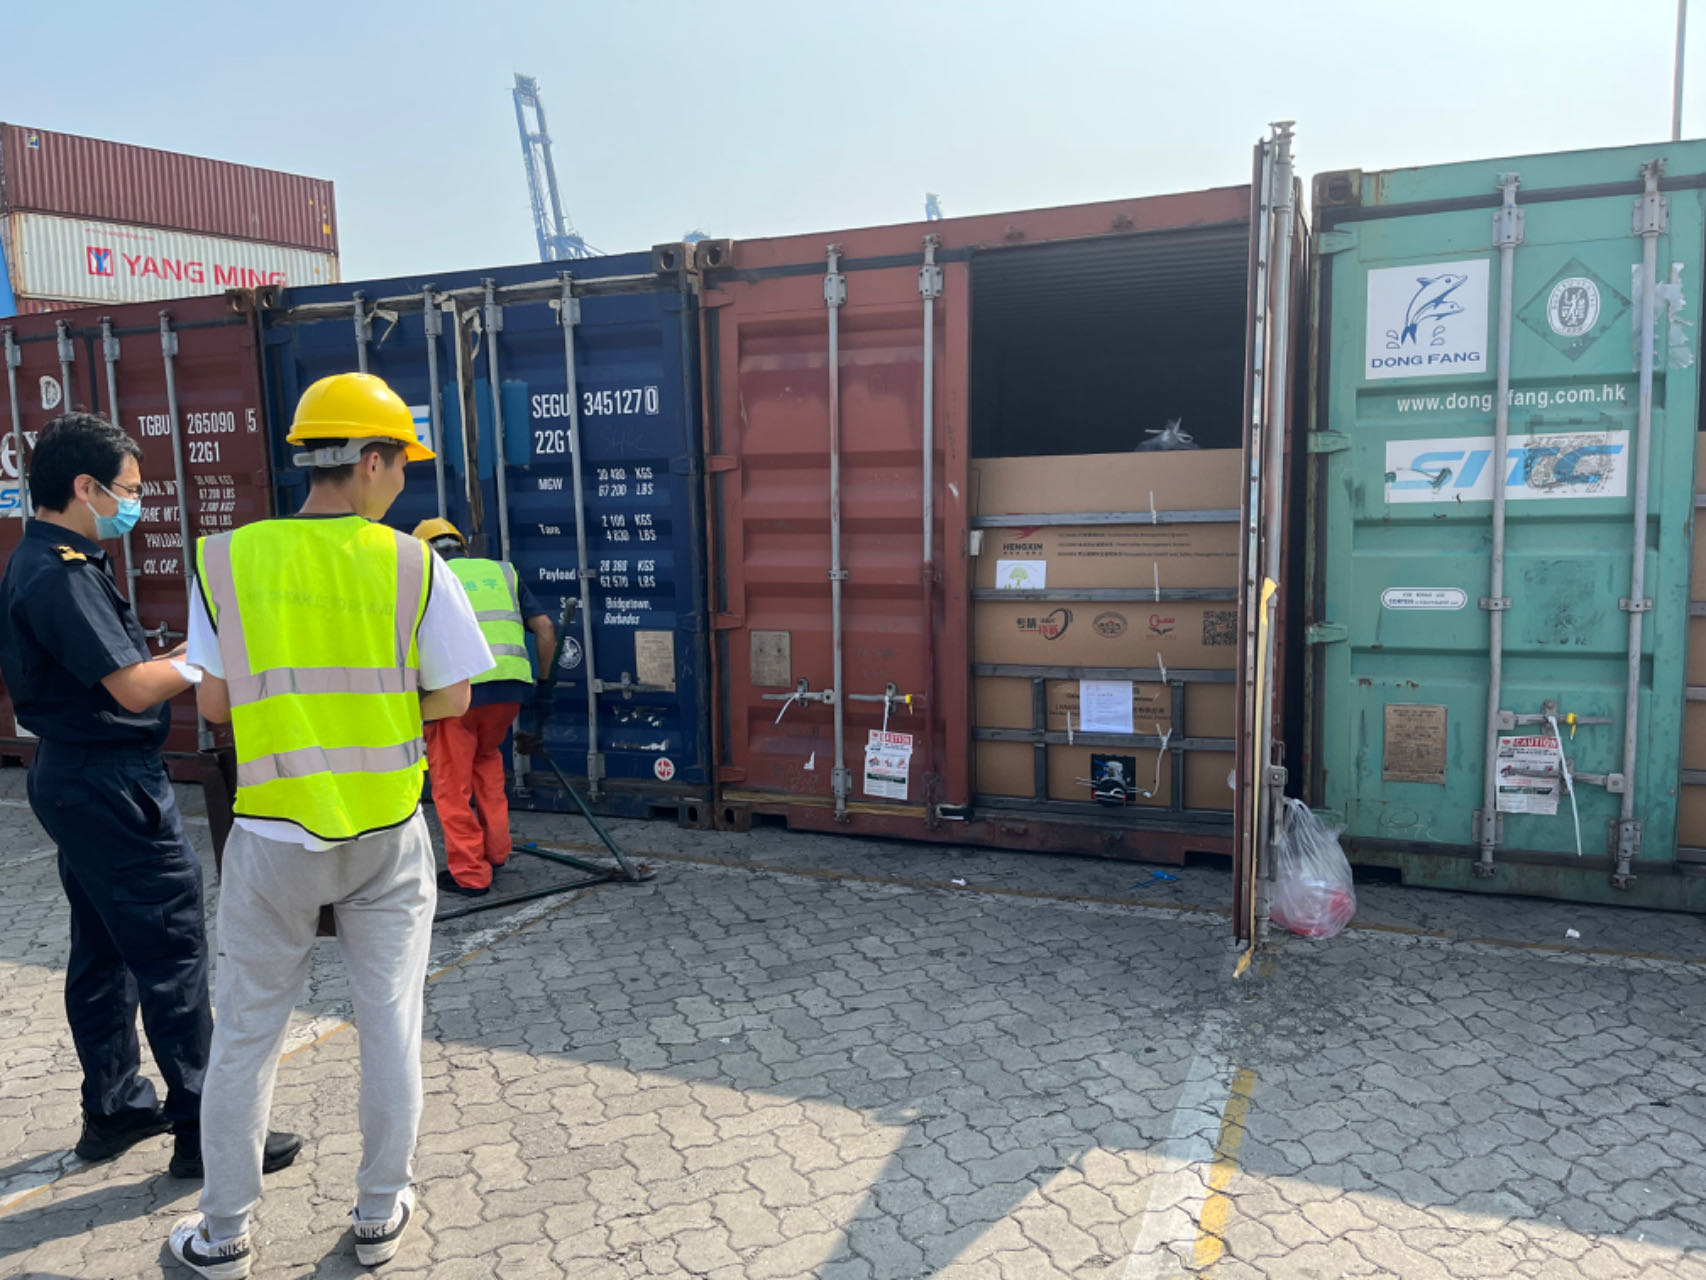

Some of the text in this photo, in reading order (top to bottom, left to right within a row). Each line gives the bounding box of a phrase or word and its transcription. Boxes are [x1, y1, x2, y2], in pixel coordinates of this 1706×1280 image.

[122, 252, 287, 288] YANG MING
[1371, 351, 1480, 368] DONG FANG
[532, 393, 571, 418] SEGU
[138, 414, 171, 437] TGBU
[187, 411, 236, 434] 265090
[534, 429, 573, 454] 22G1
[188, 441, 220, 463] 22G1
[538, 478, 563, 491] MGW
[539, 568, 576, 582] Payload
[1514, 738, 1558, 748] CAUTION
[360, 1226, 387, 1239] NIKE
[218, 1238, 248, 1257] NIKE
